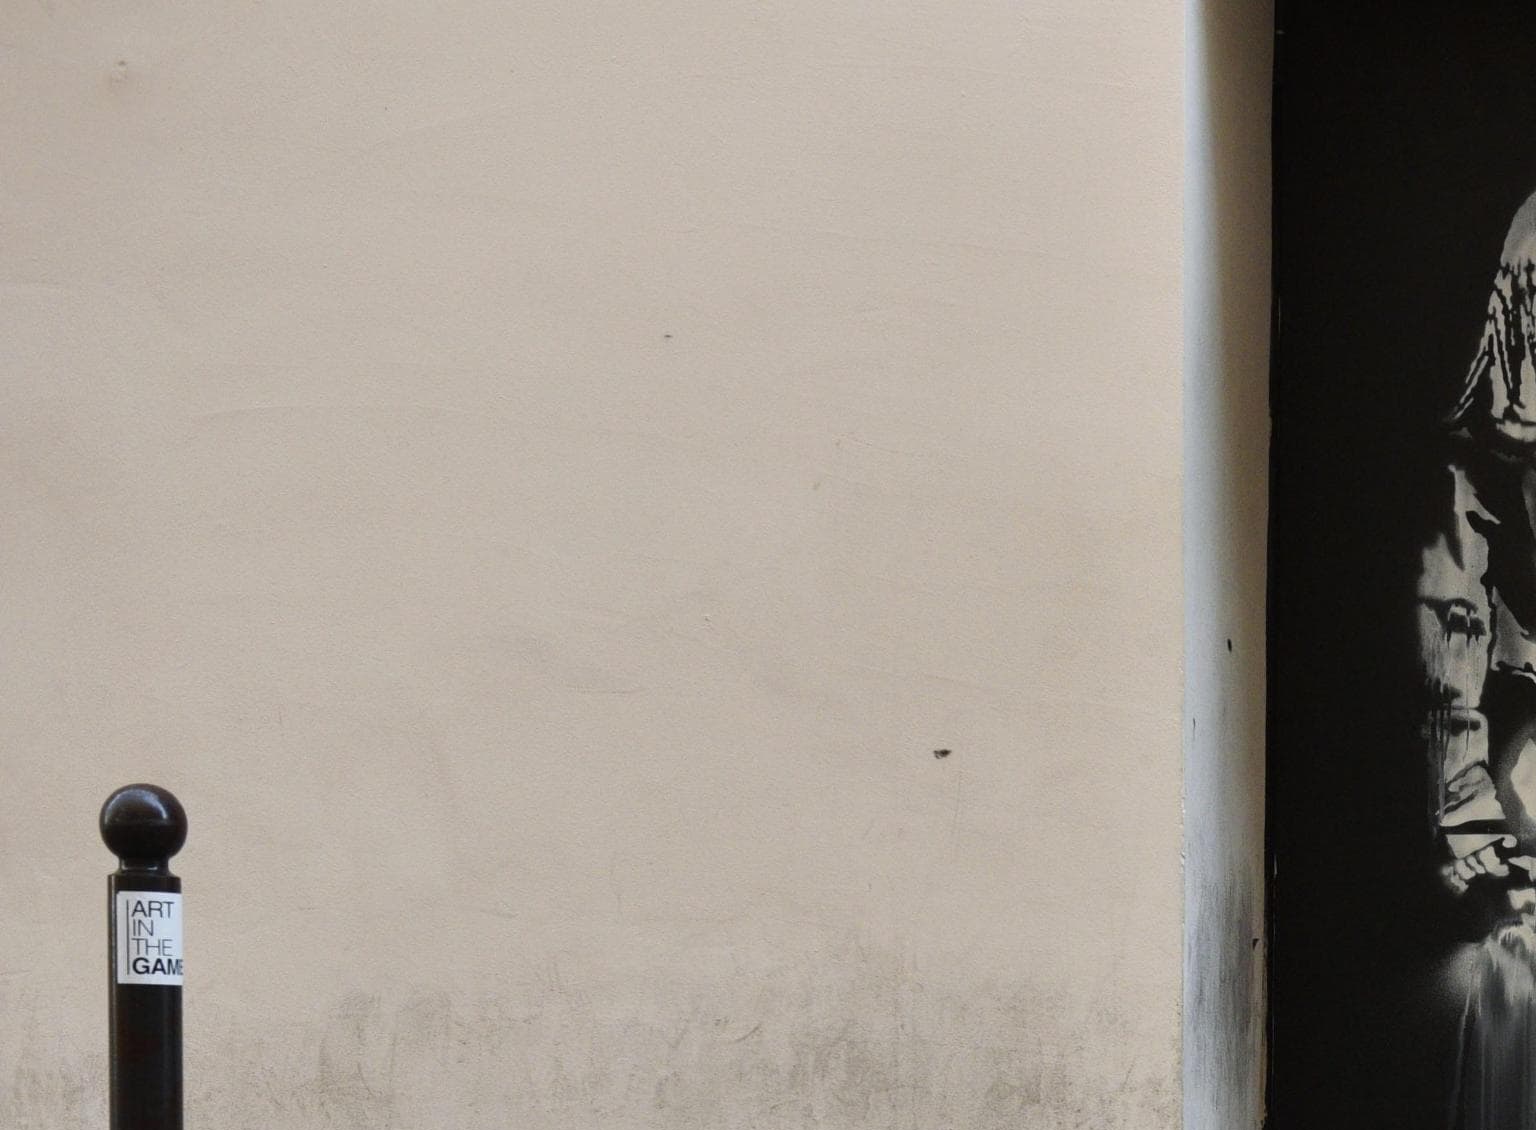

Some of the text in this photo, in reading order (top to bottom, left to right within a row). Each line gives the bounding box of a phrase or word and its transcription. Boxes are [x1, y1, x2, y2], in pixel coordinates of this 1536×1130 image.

[131, 900, 174, 918] ART
[133, 919, 154, 936] IN
[131, 937, 173, 956] THE
[132, 957, 183, 975] GAME
